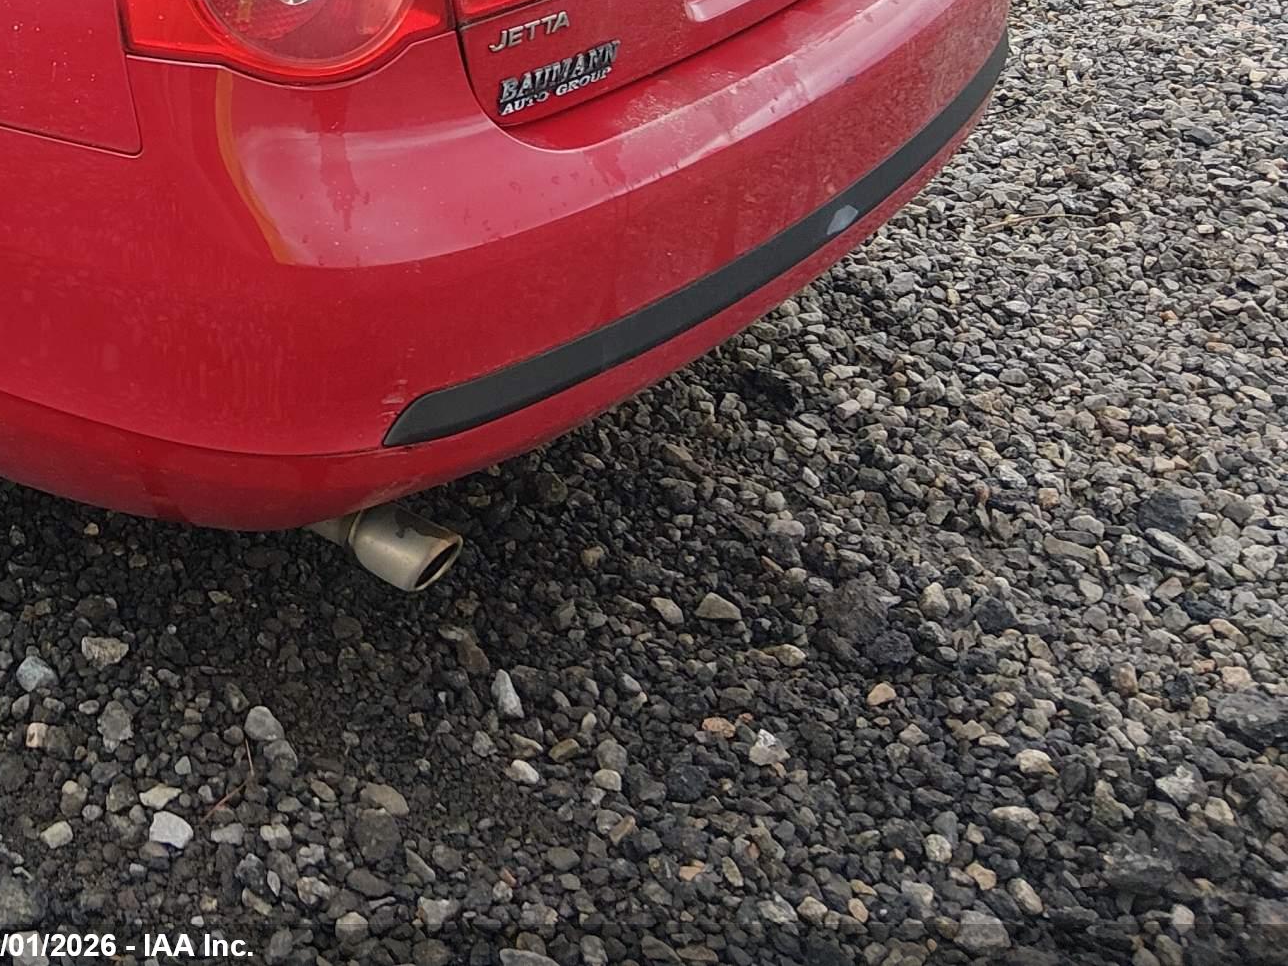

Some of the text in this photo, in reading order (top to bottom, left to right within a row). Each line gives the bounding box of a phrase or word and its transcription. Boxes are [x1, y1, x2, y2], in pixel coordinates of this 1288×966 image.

[489, 11, 570, 52] JETTA
[499, 40, 621, 103] BAUMANN
[500, 66, 612, 116] AUTO GROUP
